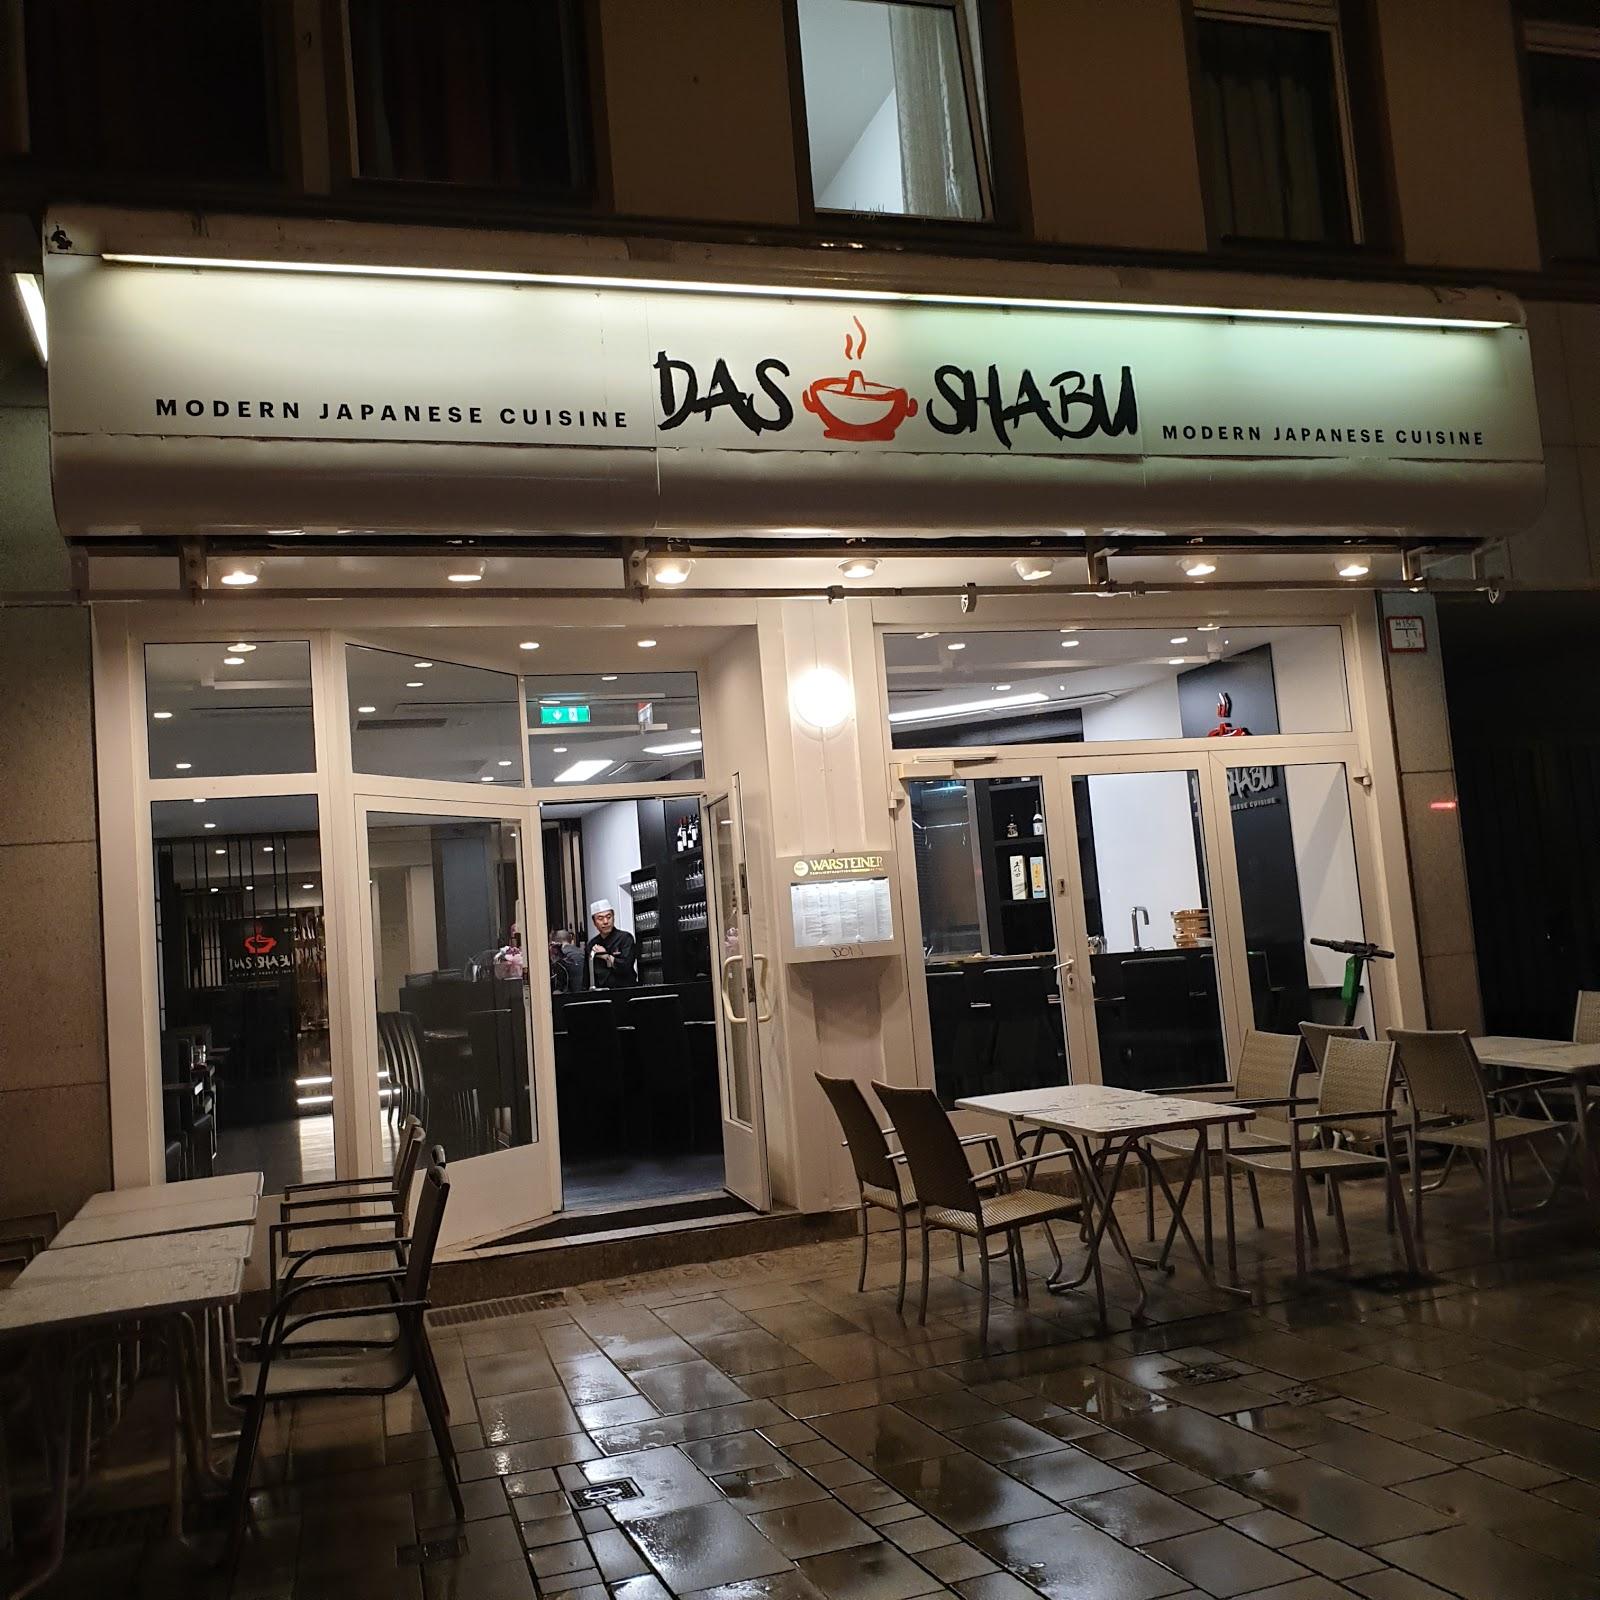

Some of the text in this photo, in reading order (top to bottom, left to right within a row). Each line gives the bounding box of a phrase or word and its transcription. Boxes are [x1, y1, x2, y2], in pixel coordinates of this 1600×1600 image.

[653, 350, 1138, 449] DAS SHABU
[155, 399, 628, 428] MODERN JAPANESE CUISINE
[1162, 425, 1484, 446] MODERN JAPANESE CUISINE
[810, 857, 883, 871] WARSTEINER
